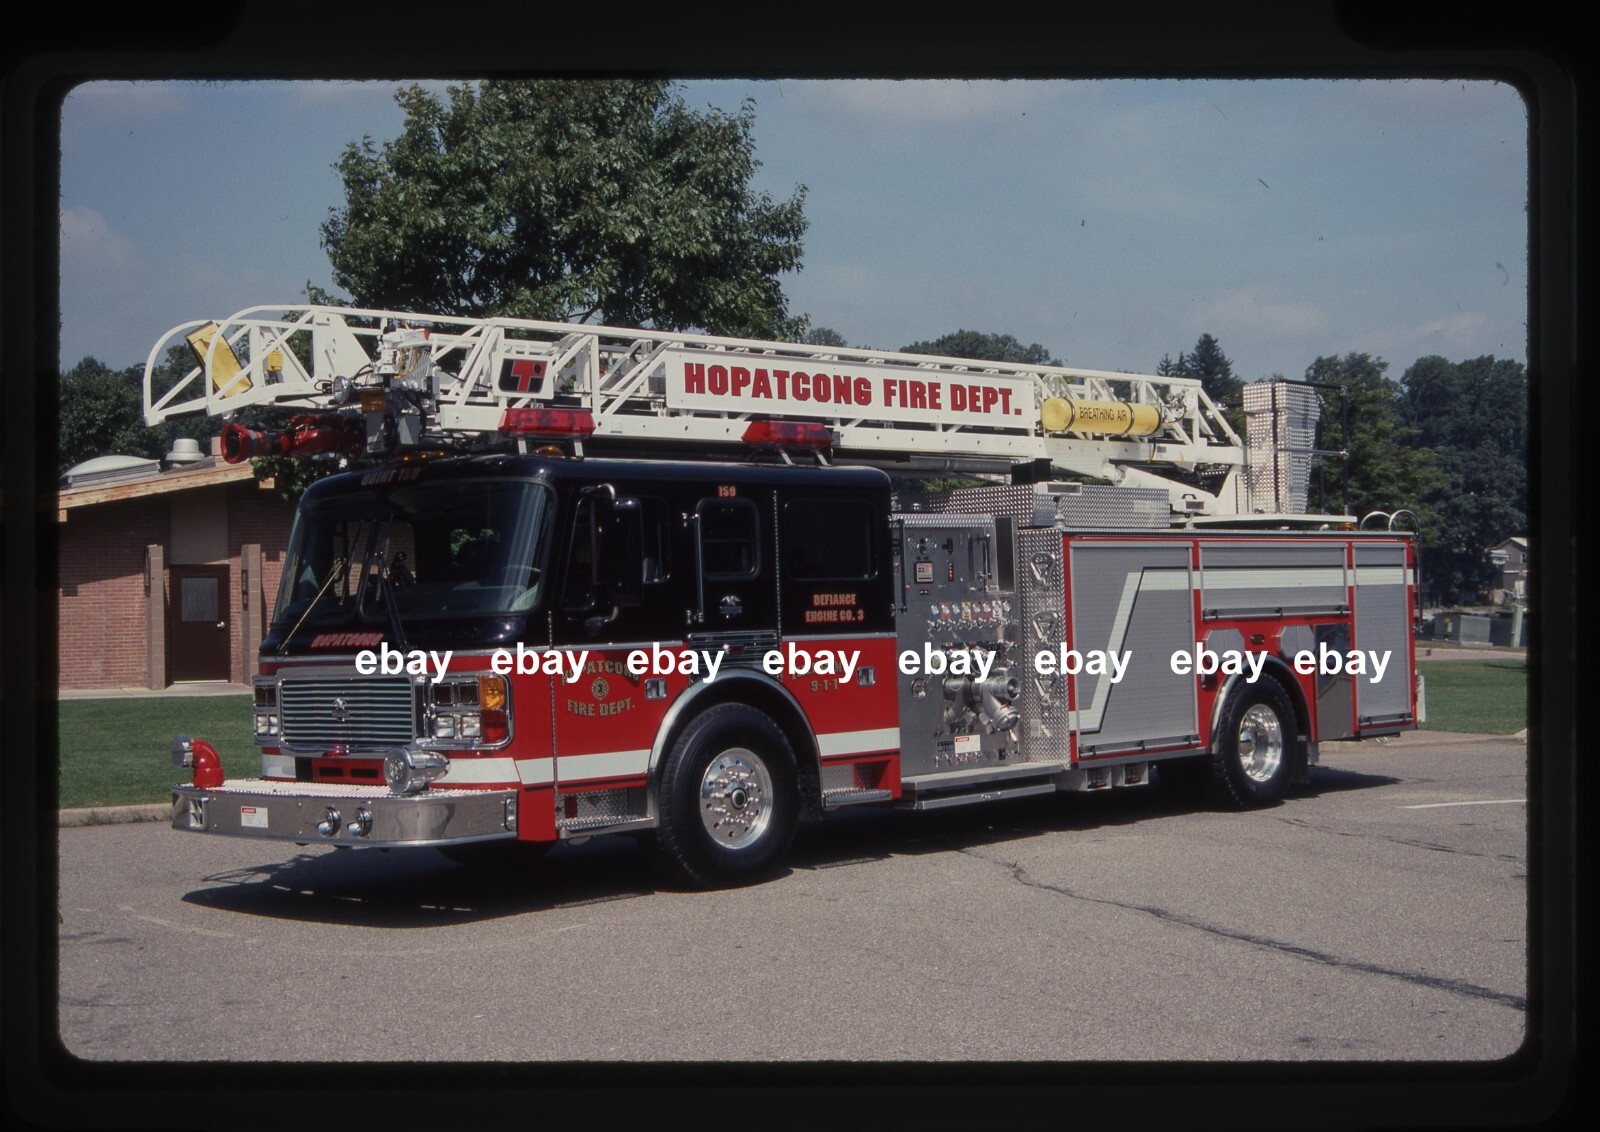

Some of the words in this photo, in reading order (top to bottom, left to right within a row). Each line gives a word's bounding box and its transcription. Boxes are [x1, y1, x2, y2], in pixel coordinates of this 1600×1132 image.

[684, 362, 872, 406] HOPATCONG
[883, 378, 942, 410] FIRE
[950, 383, 1022, 415] DEPT.
[1079, 406, 1115, 420] BREATHING
[1117, 409, 1128, 421] AIR
[718, 485, 736, 497] 159
[813, 593, 856, 606] DEFIANCE
[805, 610, 838, 623] ENGINE
[839, 609, 856, 621] CO.
[857, 609, 864, 621] 3
[810, 679, 838, 692] 9-1-1
[567, 698, 596, 717] FIRE
[599, 698, 635, 717] DEPT.
